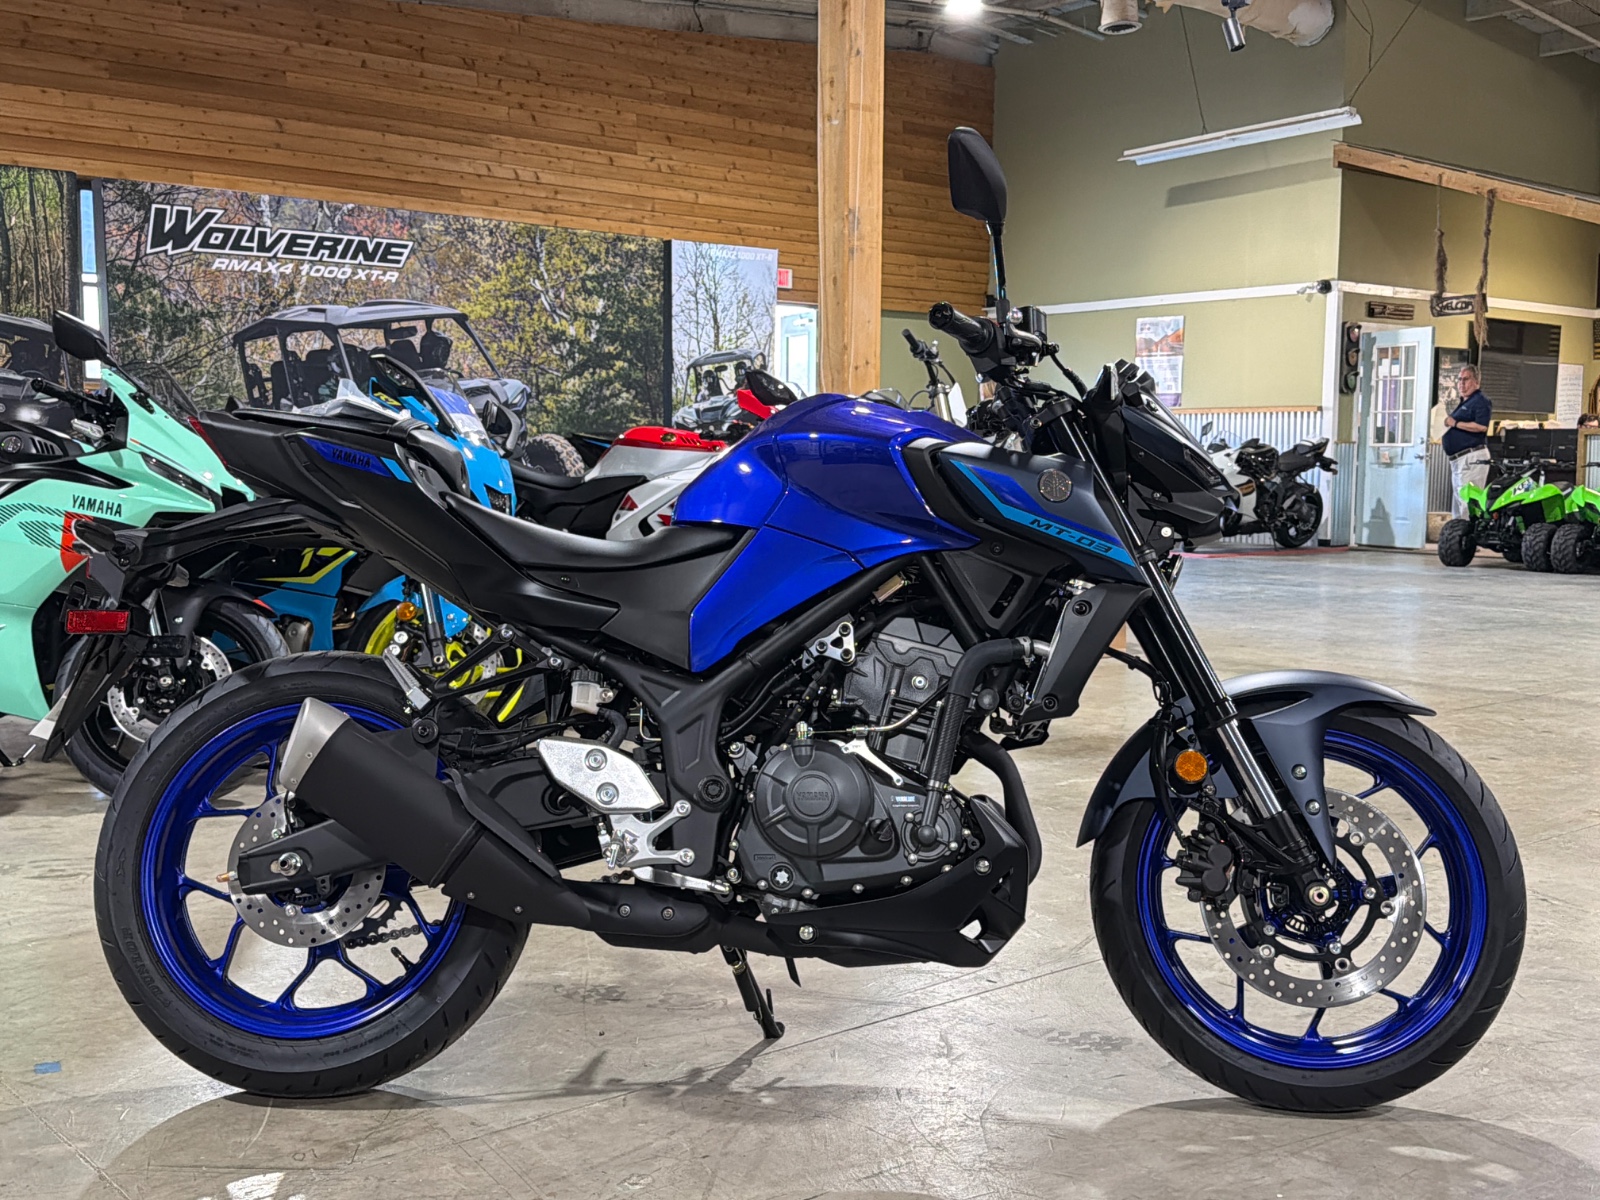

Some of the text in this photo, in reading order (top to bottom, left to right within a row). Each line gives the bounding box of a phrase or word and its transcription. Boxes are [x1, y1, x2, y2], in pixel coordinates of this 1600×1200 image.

[146, 203, 413, 268] WOLVERINE
[738, 252, 755, 260] 1000
[756, 253, 774, 261] XT-R
[211, 258, 399, 283] RMAX4 1000 XT-R
[331, 448, 372, 468] YAMAHA
[72, 494, 122, 517] YAMAHA
[1029, 518, 1113, 553] MT-03
